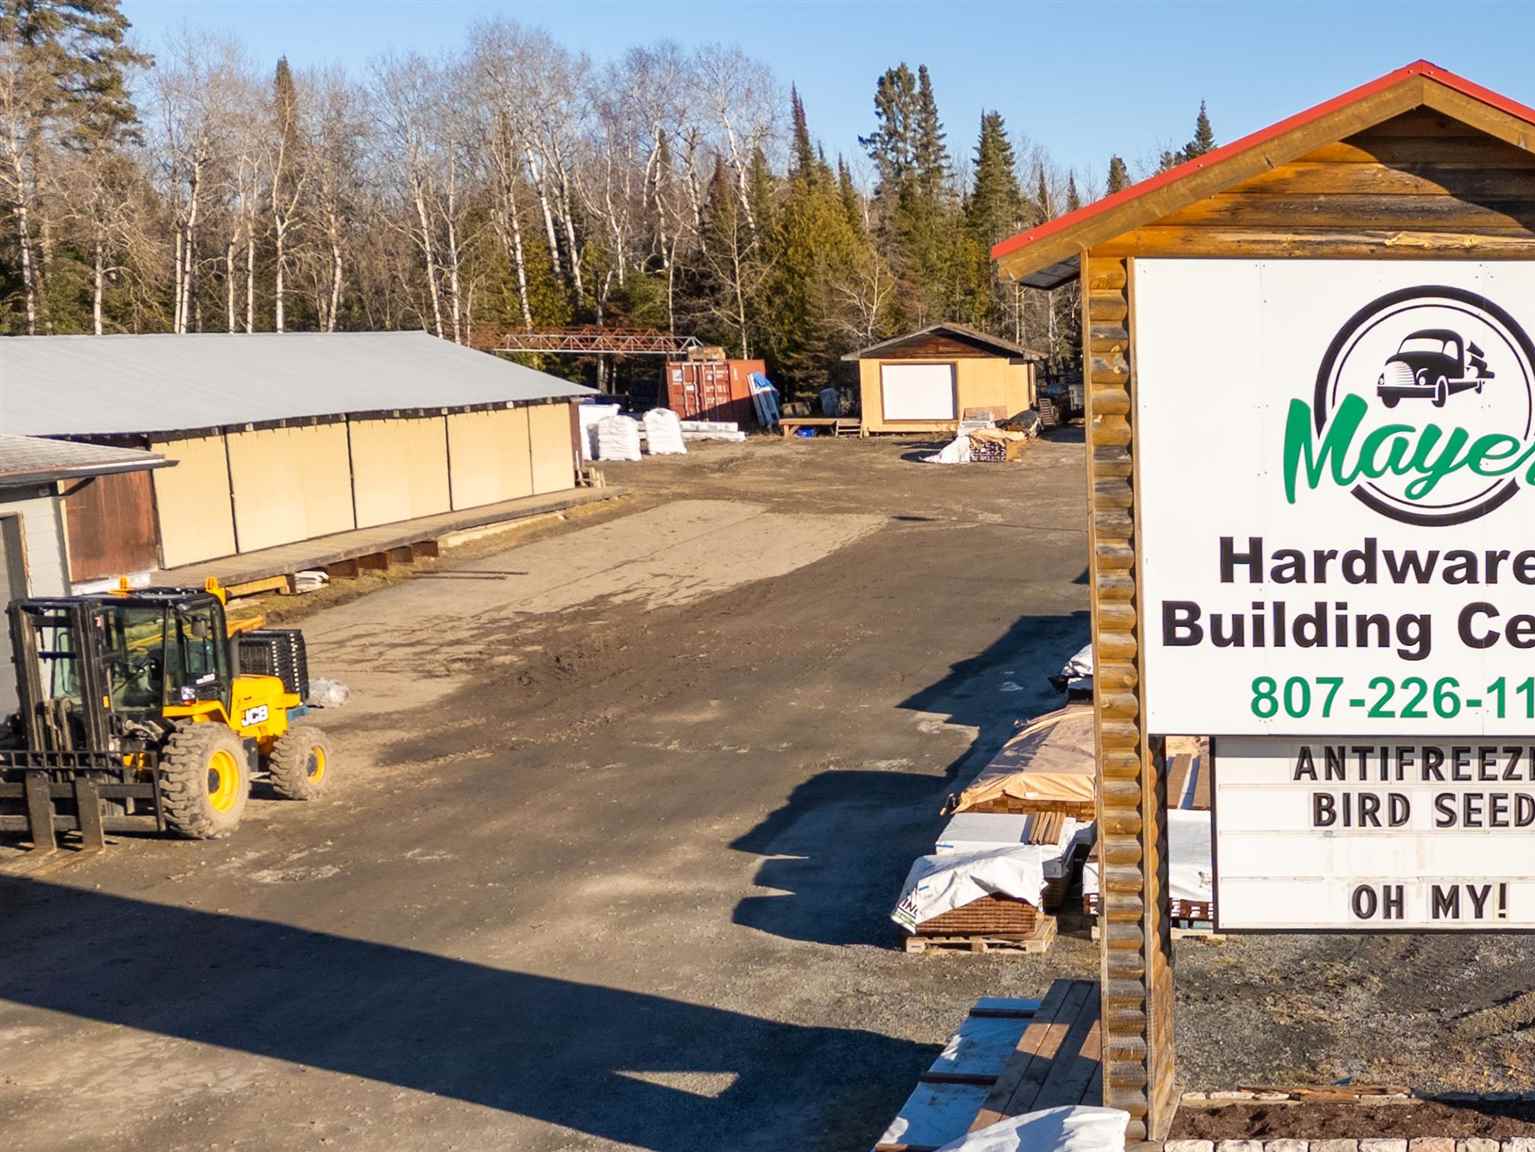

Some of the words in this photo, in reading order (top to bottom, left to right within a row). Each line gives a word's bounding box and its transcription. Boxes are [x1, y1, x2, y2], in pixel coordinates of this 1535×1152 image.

[1161, 601, 1432, 661] Building
[241, 704, 269, 727] JCB
[1312, 792, 1411, 828] BIRD
[1351, 884, 1405, 920] OH
[1431, 883, 1509, 920] MY!
